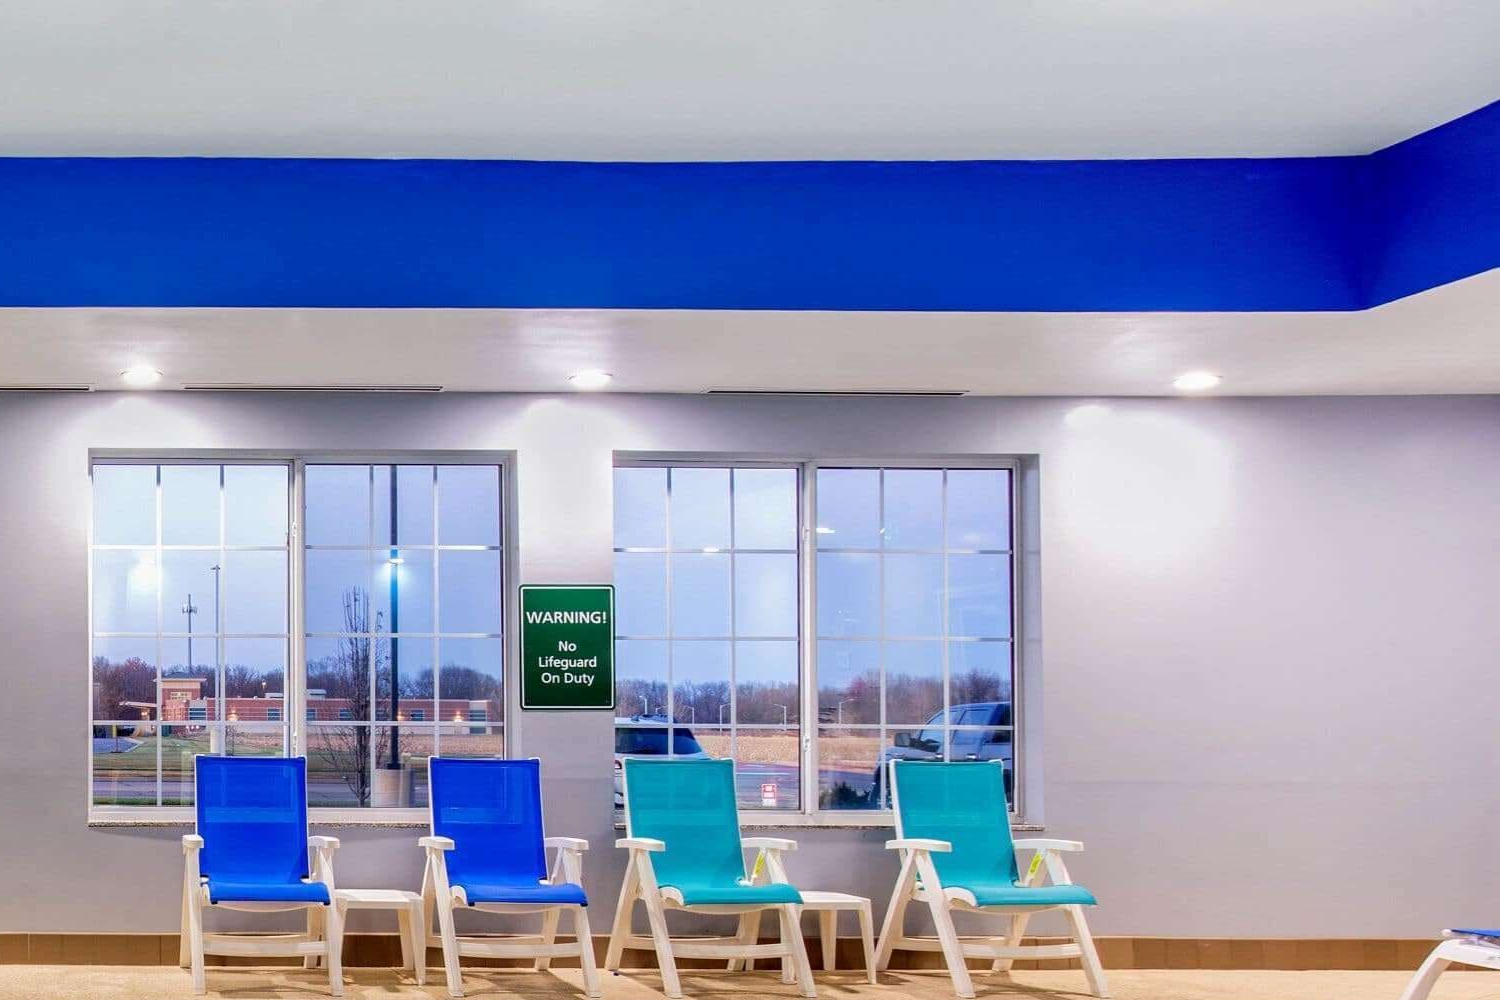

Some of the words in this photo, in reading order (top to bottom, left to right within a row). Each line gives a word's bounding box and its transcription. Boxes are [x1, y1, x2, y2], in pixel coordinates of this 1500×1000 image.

[526, 611, 607, 624] WARNING!
[558, 640, 577, 652] No
[538, 656, 597, 670] Lifeguard
[541, 672, 560, 684] On
[564, 672, 595, 686] Duty
